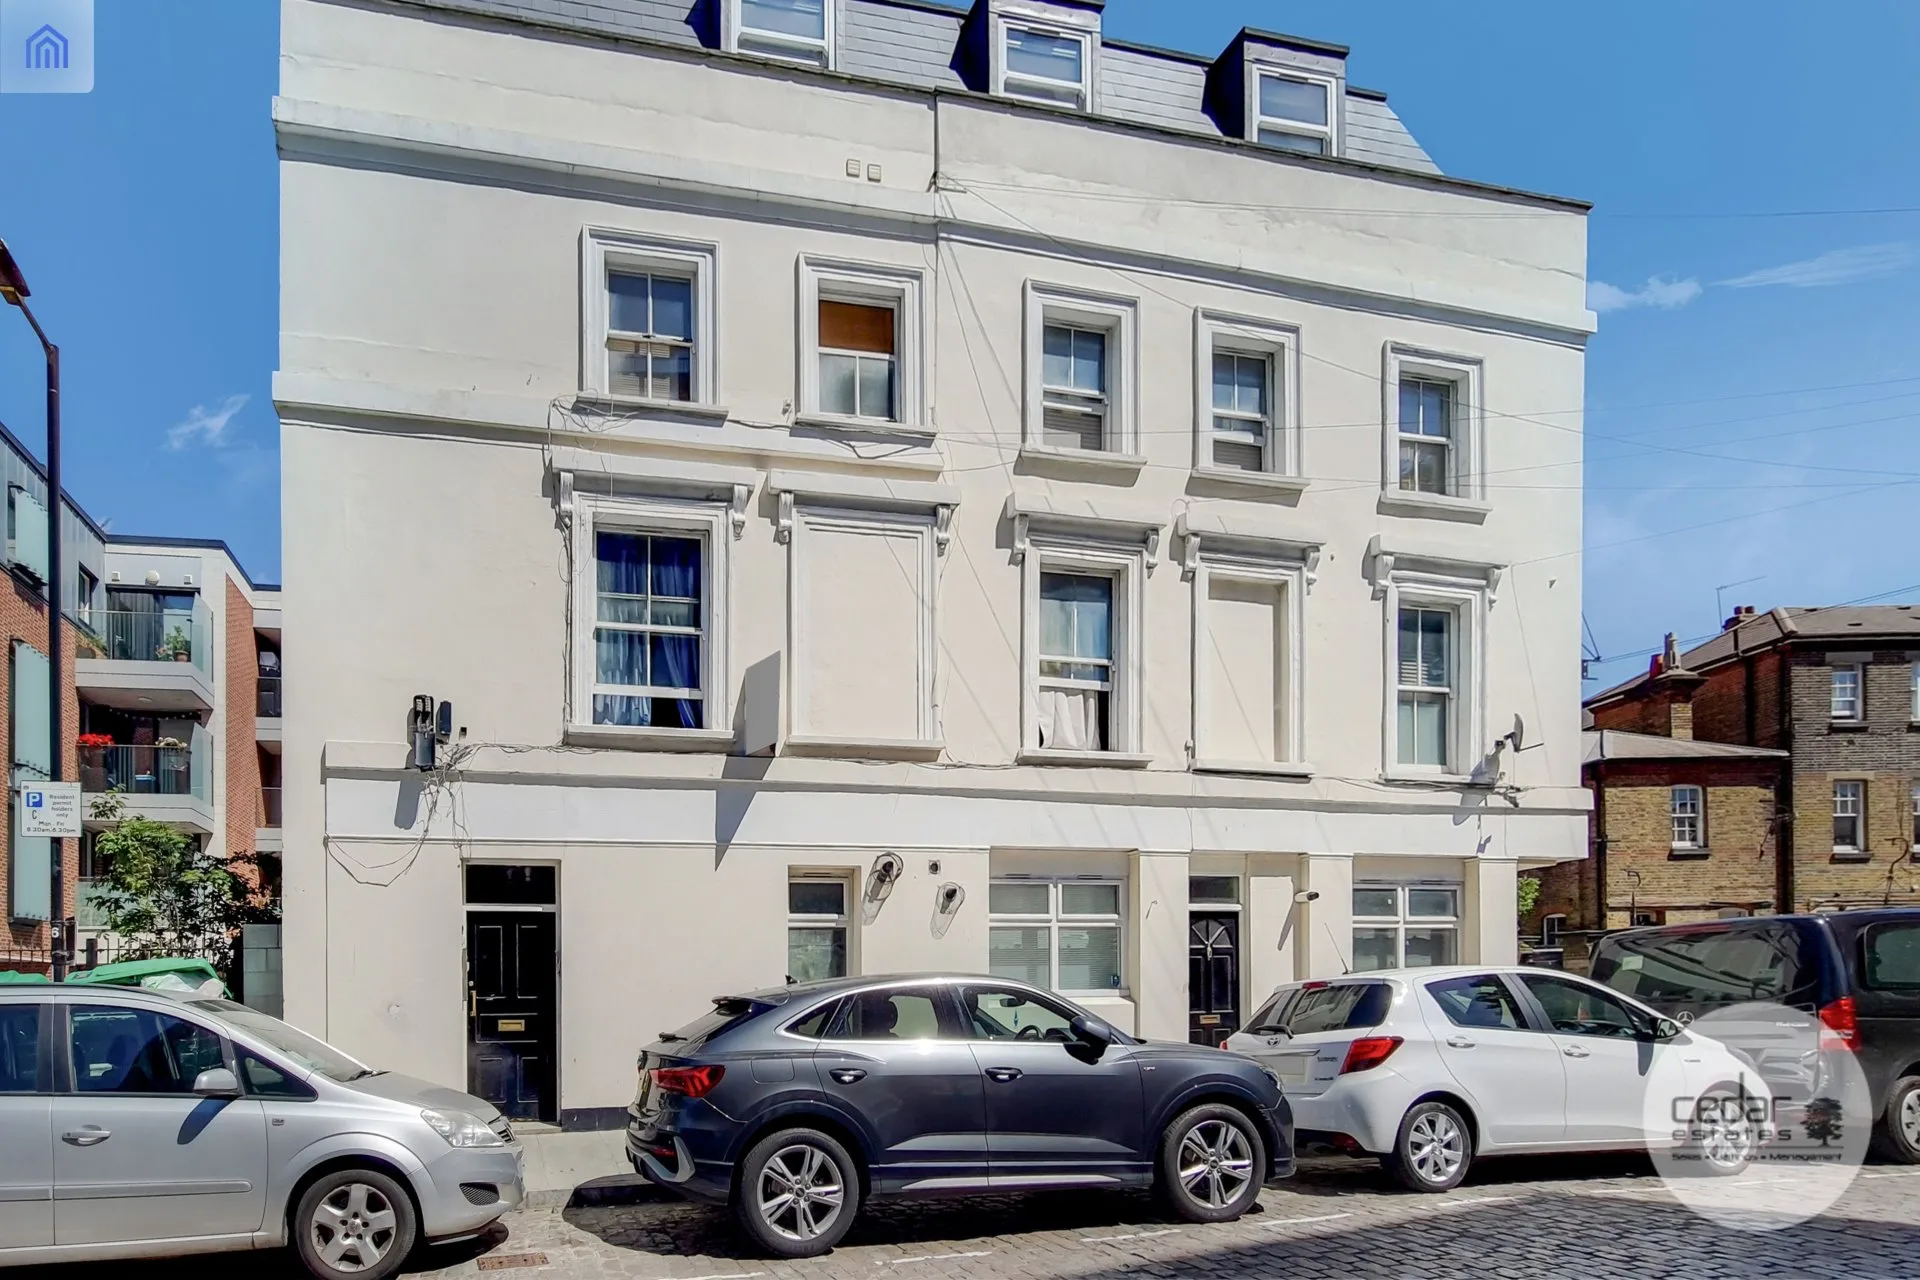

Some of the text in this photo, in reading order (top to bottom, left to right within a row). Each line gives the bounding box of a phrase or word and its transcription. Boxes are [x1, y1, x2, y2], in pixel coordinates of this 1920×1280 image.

[29, 793, 40, 806] P
[31, 809, 38, 820] C
[51, 927, 60, 938] 6
